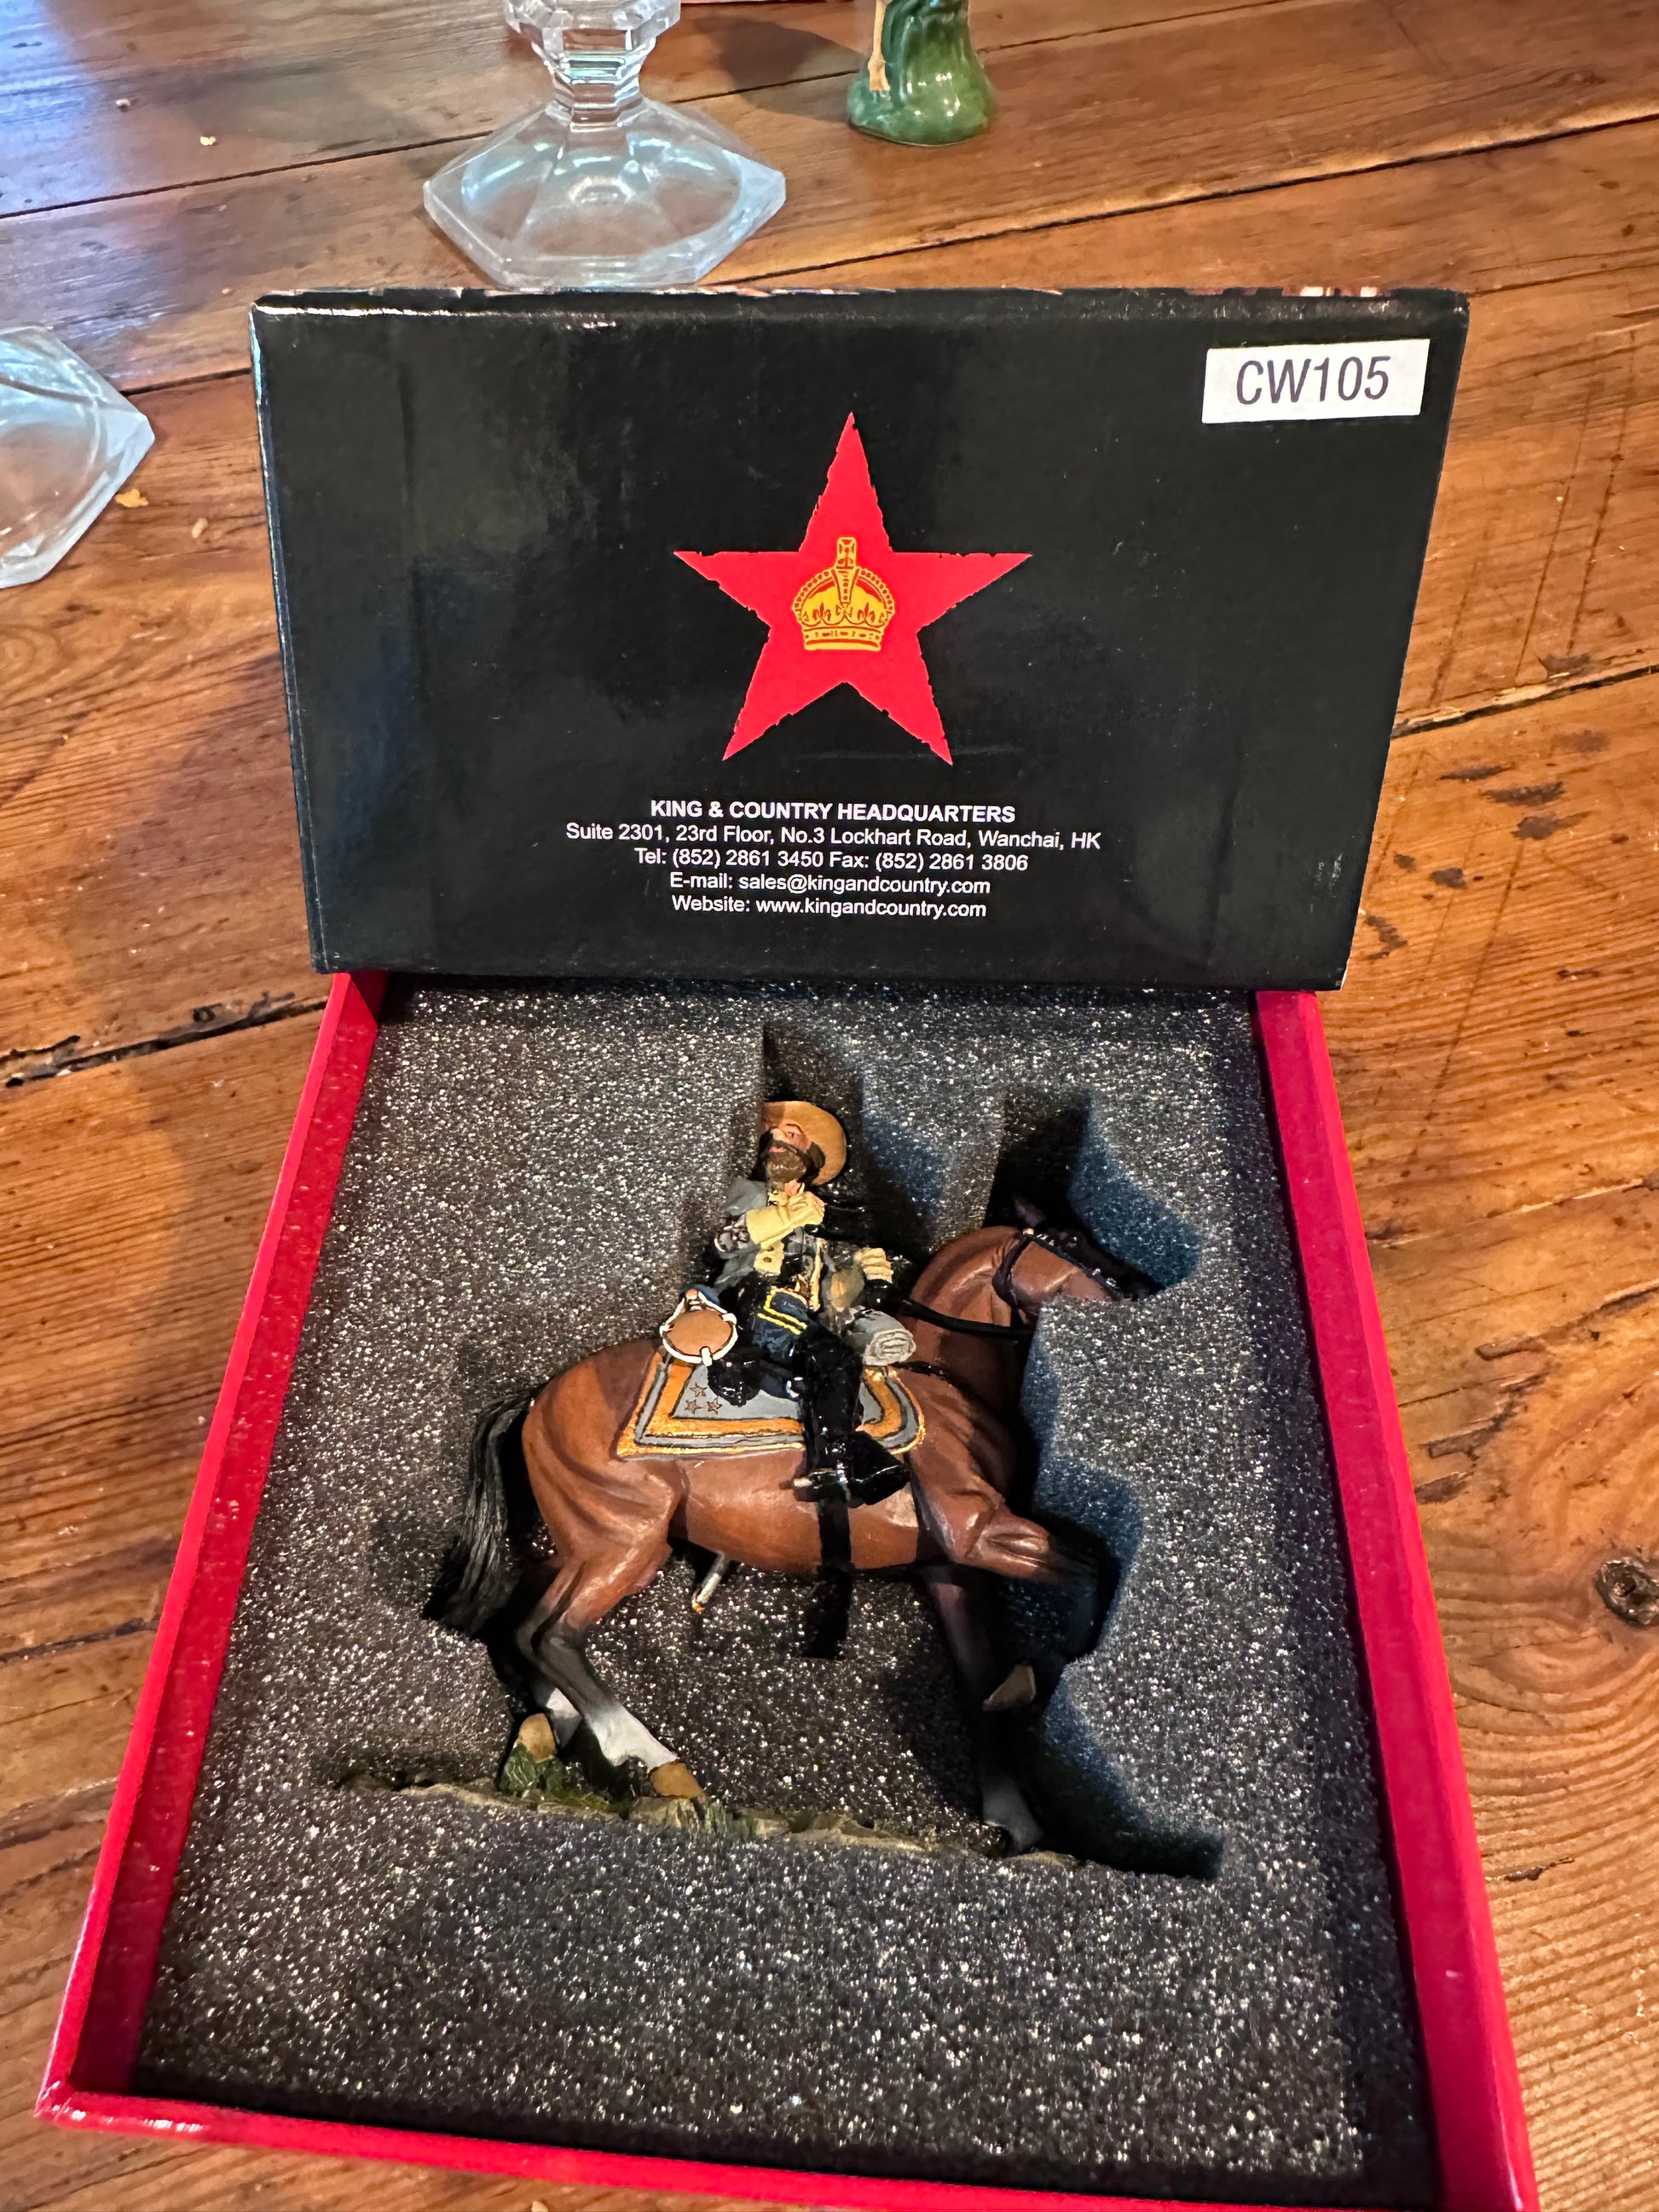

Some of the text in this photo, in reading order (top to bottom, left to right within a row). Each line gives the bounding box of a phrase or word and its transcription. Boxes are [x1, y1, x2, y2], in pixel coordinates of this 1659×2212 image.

[1236, 355, 1390, 405] CW105
[650, 800, 1016, 823] KING & COUNTRY HEADQUARTERS
[565, 822, 1102, 851] Suite 2301, 23rd Floor, No.3 Lockhart Road, Wanchai, HK
[633, 846, 1029, 874] Tel: (852) 2861 3450 Fax: (852) 2861 3806
[669, 871, 991, 898] E-mail: sales@kingandcountry.com
[671, 894, 987, 921] Website: www.kingandcountry.com
